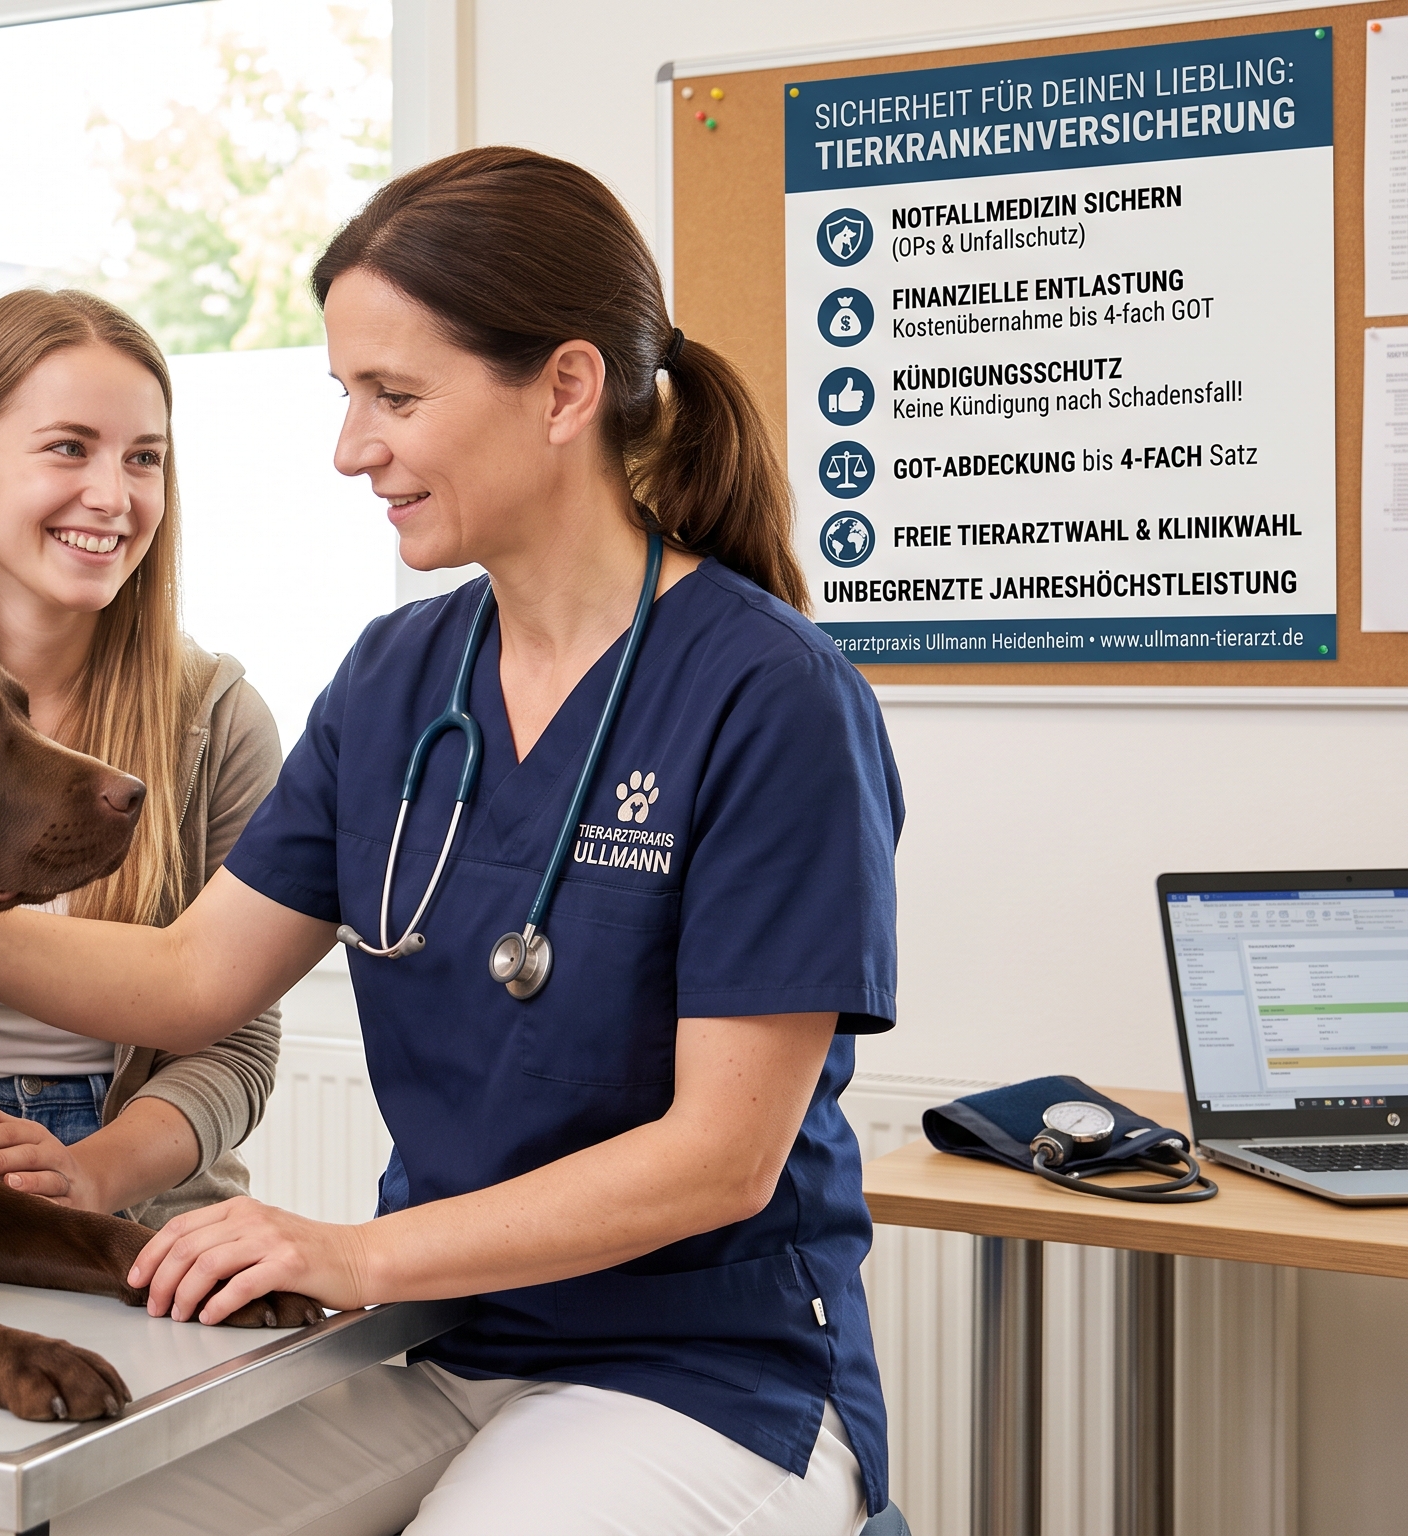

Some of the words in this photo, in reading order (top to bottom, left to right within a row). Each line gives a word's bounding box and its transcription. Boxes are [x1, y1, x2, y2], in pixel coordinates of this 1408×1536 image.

[815, 88, 973, 130] SICHERHEIT
[981, 79, 1033, 114] FÜR
[1042, 71, 1145, 108] DEINEN
[1156, 56, 1294, 97] LIEBLING:
[815, 96, 1295, 171] TIERKRANKENVERSICHERUNG
[892, 193, 1077, 230] NOTFALLMEDIZIN
[1083, 184, 1182, 214] SICHERN
[892, 236, 936, 263] (OPs
[941, 233, 954, 255] &
[960, 221, 1085, 253] Unfallschutz)
[892, 279, 1029, 311] FINANZIELLE
[1035, 268, 1184, 301] ENTLASTUNG
[893, 309, 1063, 339] Kostenübernahme
[1069, 305, 1098, 328] bis
[1103, 300, 1165, 325] 4-fach
[1171, 297, 1214, 321] GOT
[893, 357, 1123, 391] KÜNDIGUNGSSCHUTZ
[893, 397, 944, 419] Keine
[950, 393, 1049, 419] Kündigung
[1056, 387, 1102, 411] nach
[1108, 379, 1242, 409] Schadensfall!
[893, 450, 1076, 480] GOT-ABDECKUNG
[1083, 448, 1113, 472] bis
[1120, 444, 1202, 470] 4-FACH
[1209, 443, 1258, 467] Satz
[894, 525, 952, 548] FREIE
[957, 519, 1129, 546] TIERARZTWAHL
[1135, 518, 1151, 541] &
[1158, 513, 1303, 540] KLINIKWAHL
[823, 577, 983, 604] UNBEGRENZTE
[989, 569, 1297, 600] JAHRESHÖCHSTLEISTUNG
[833, 636, 921, 655] erarztpraxis
[926, 632, 987, 651] Ullmann
[992, 631, 1084, 649] Heidenheim
[1100, 627, 1304, 648] www.ullmann-tierarzt.de
[573, 840, 672, 875] ULLMANN
